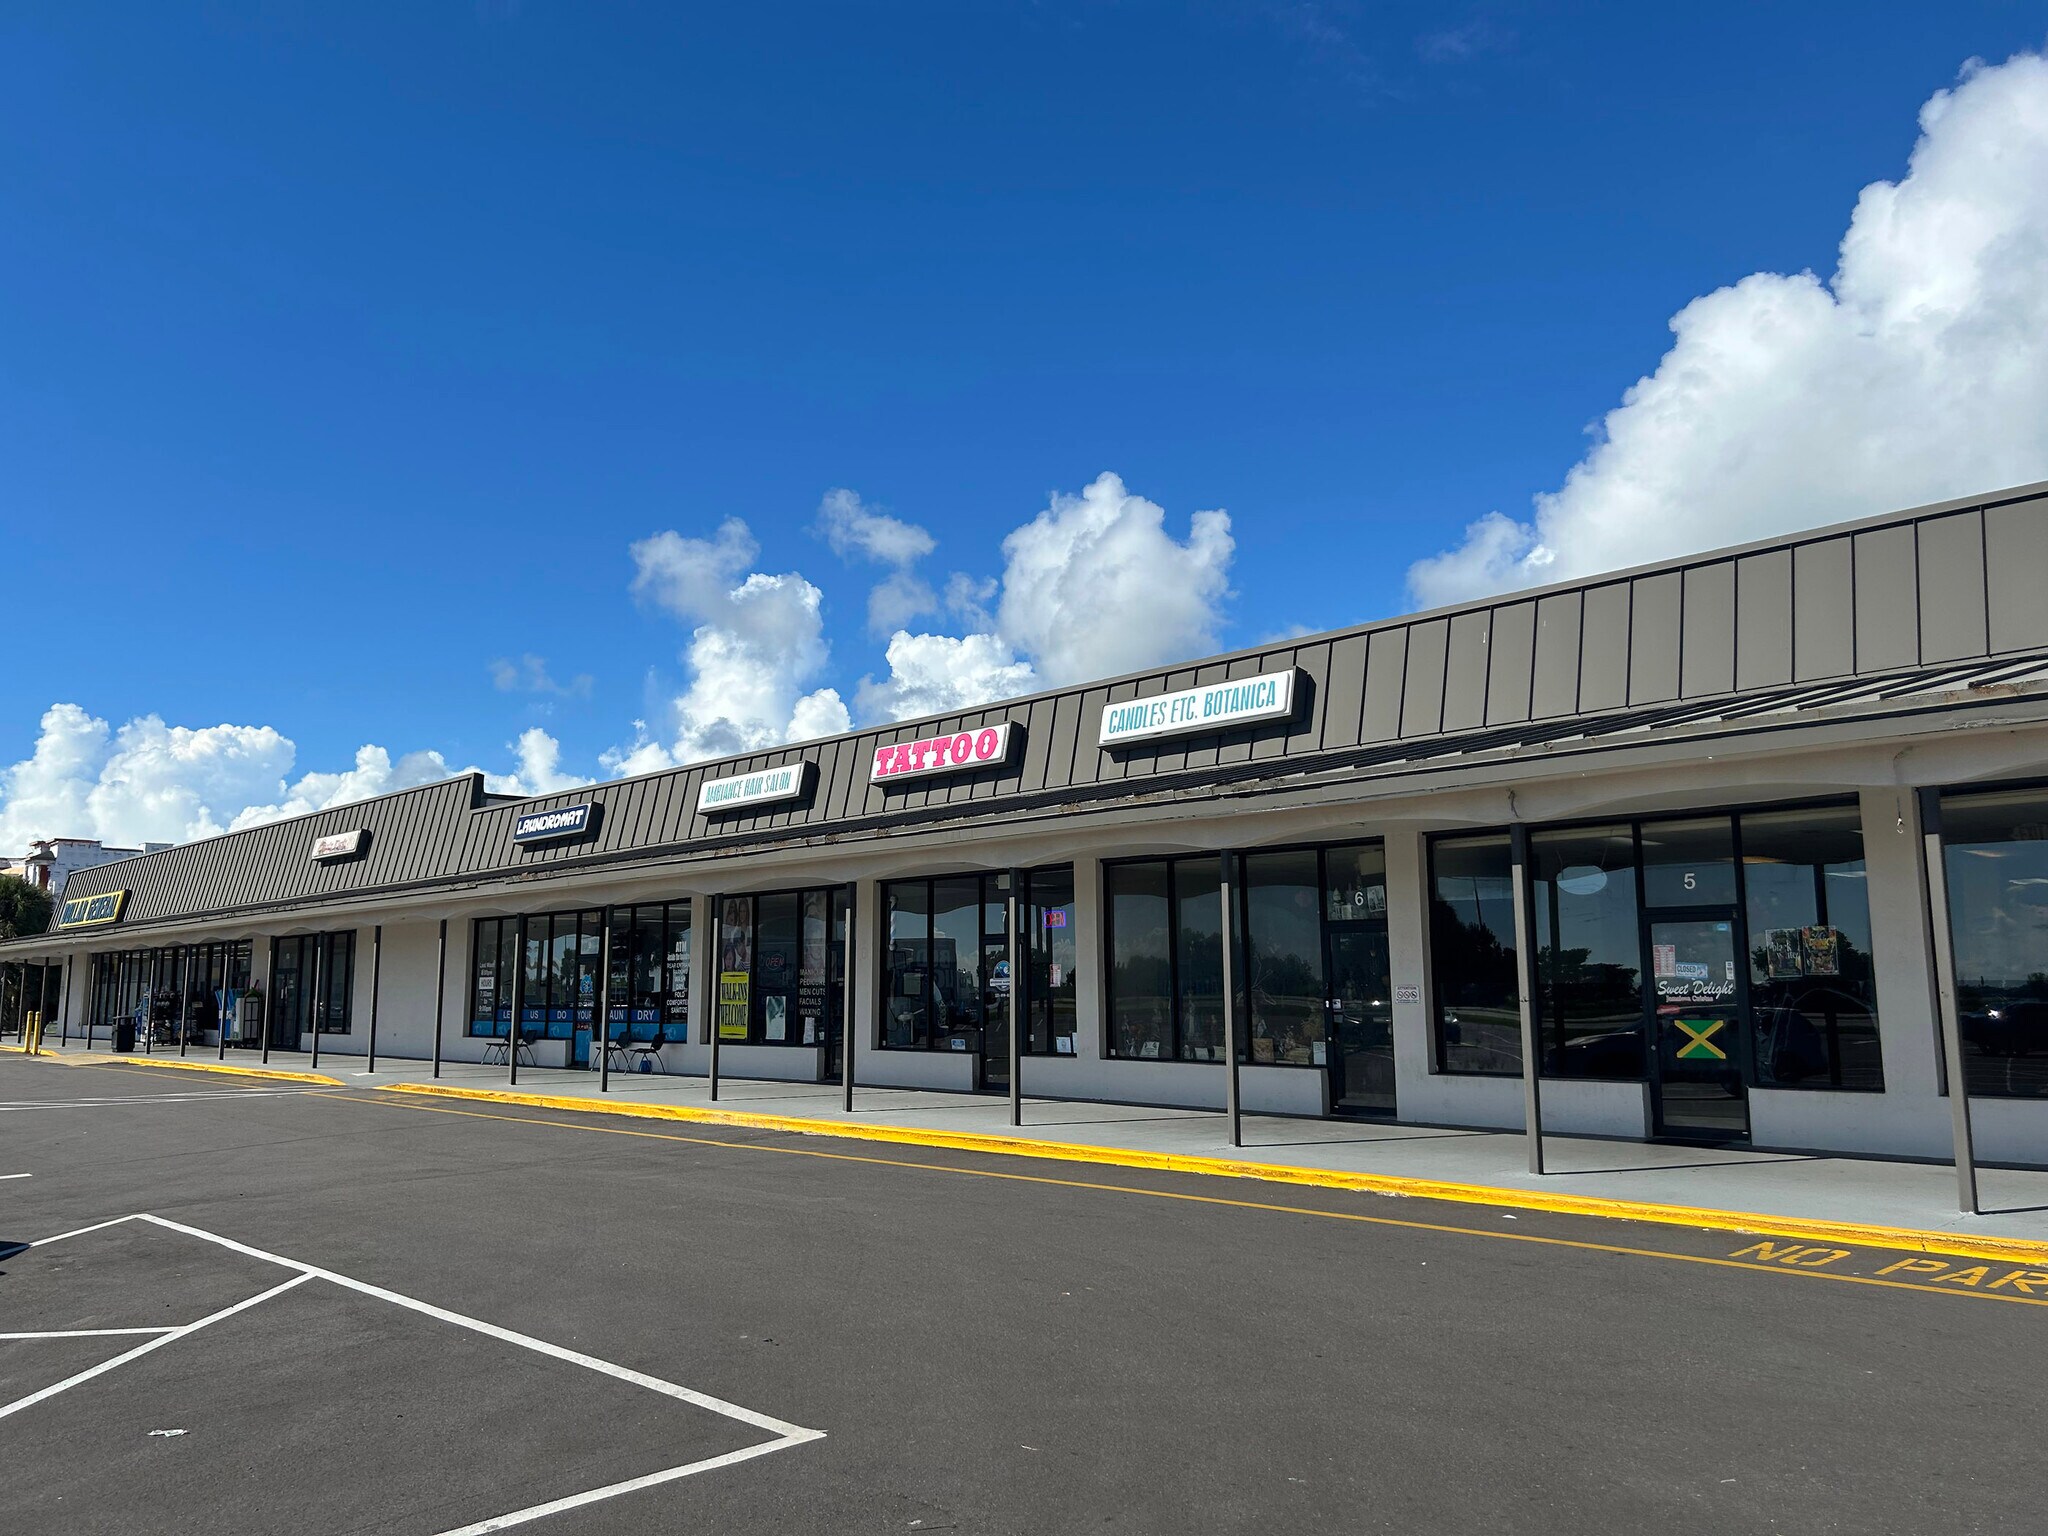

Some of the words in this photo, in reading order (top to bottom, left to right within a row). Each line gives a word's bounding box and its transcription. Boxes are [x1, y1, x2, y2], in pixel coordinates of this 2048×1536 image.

[1108, 701, 1167, 734] CANDLES
[1170, 695, 1198, 723] ETC.
[1203, 680, 1276, 717] BOTANICA
[876, 728, 998, 776] TATTOO
[705, 780, 743, 804] AMBIANCE
[743, 776, 764, 797] HAIR
[764, 771, 792, 793] SALON
[516, 809, 584, 835] LAUNDROMAT
[1683, 873, 1696, 890] 5
[1354, 891, 1364, 906] 6
[1001, 911, 1007, 922] 7
[1045, 912, 1064, 926] OPEN
[675, 941, 687, 953] ATM
[767, 956, 784, 967] OPEN
[1676, 965, 1697, 973] CLOSED
[722, 983, 747, 1001] WALK-INS
[799, 988, 811, 996] MEN
[1657, 980, 1689, 995] Sweet
[1693, 980, 1734, 1000] Delight
[799, 998, 821, 1006] FACIALS
[529, 1011, 539, 1019] US
[557, 1011, 567, 1019] DO
[609, 1010, 624, 1020] AUN
[637, 1010, 655, 1020] DRY
[720, 1004, 746, 1027] WELCOME
[799, 1008, 821, 1016] WAXING
[1728, 1241, 1852, 1267] NO
[1873, 1258, 2048, 1295] PAR
